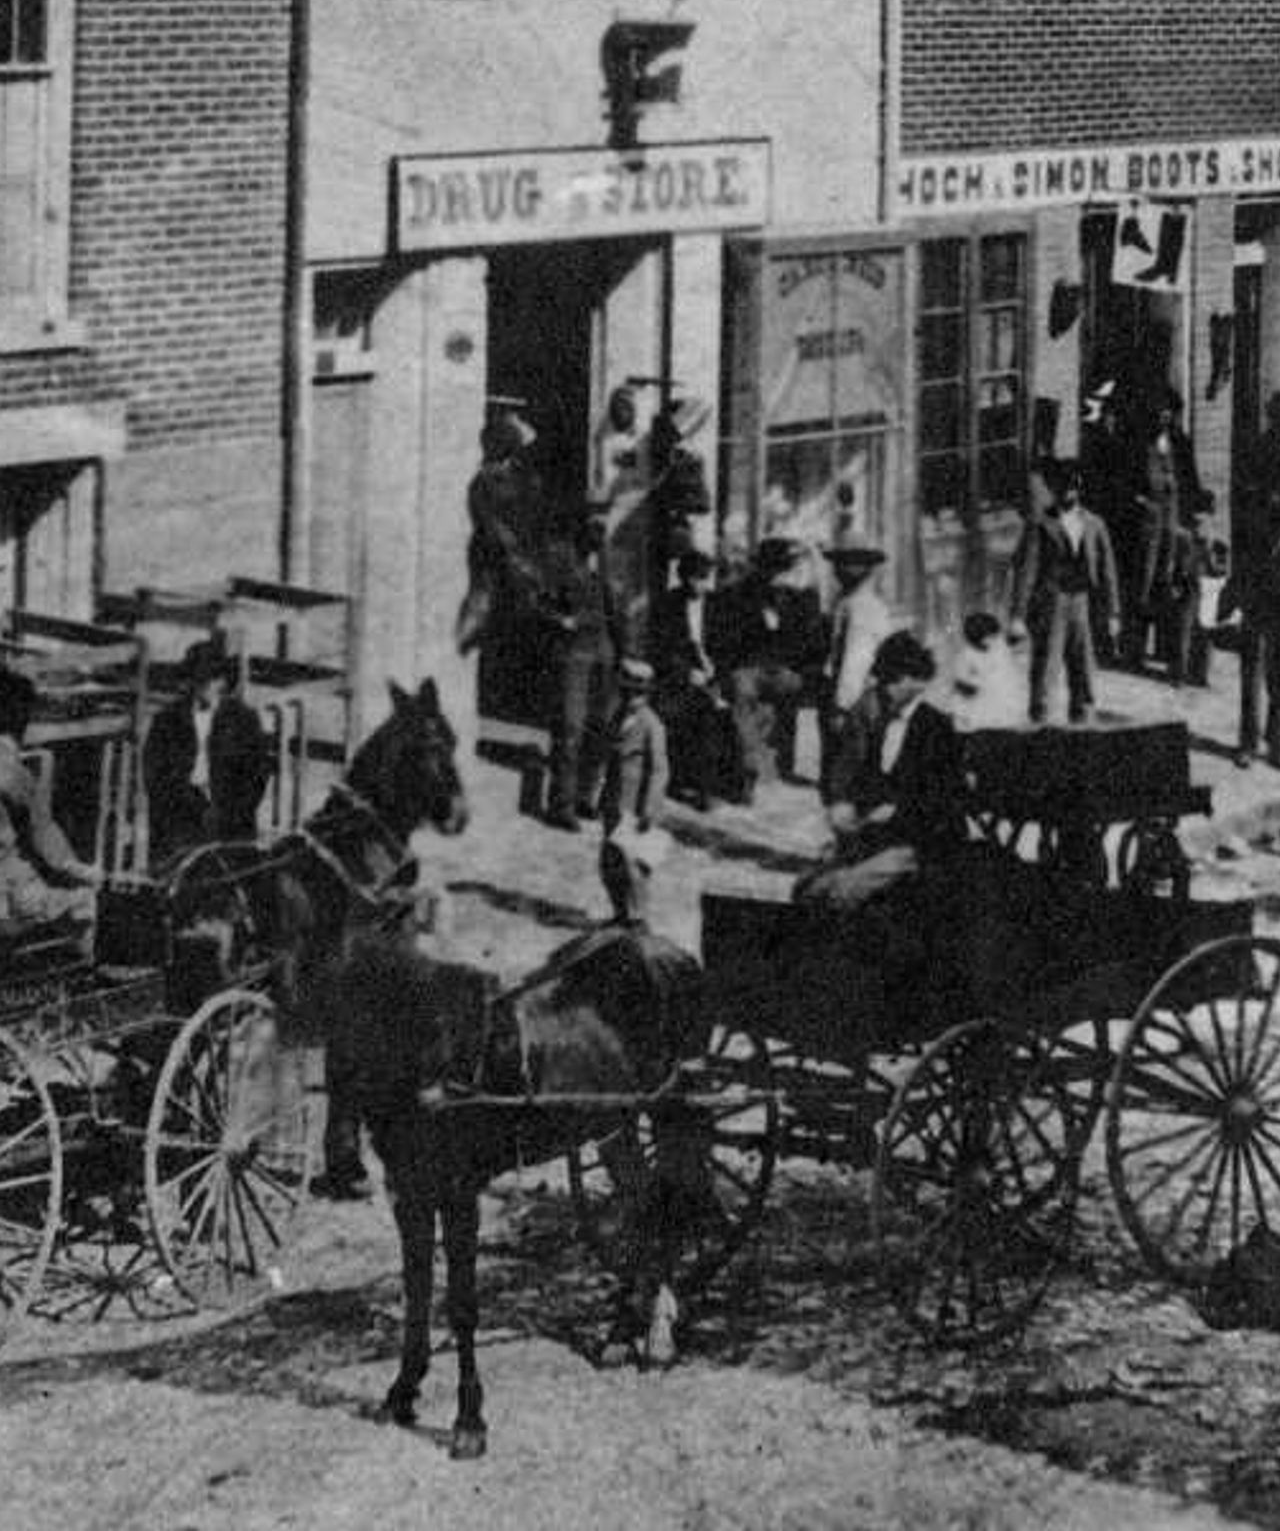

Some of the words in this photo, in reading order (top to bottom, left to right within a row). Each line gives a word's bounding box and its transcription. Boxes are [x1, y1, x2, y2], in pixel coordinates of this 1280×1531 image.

[406, 168, 543, 230] DRUG
[1012, 155, 1111, 199] SIMON
[1126, 149, 1221, 191] BOOTS
